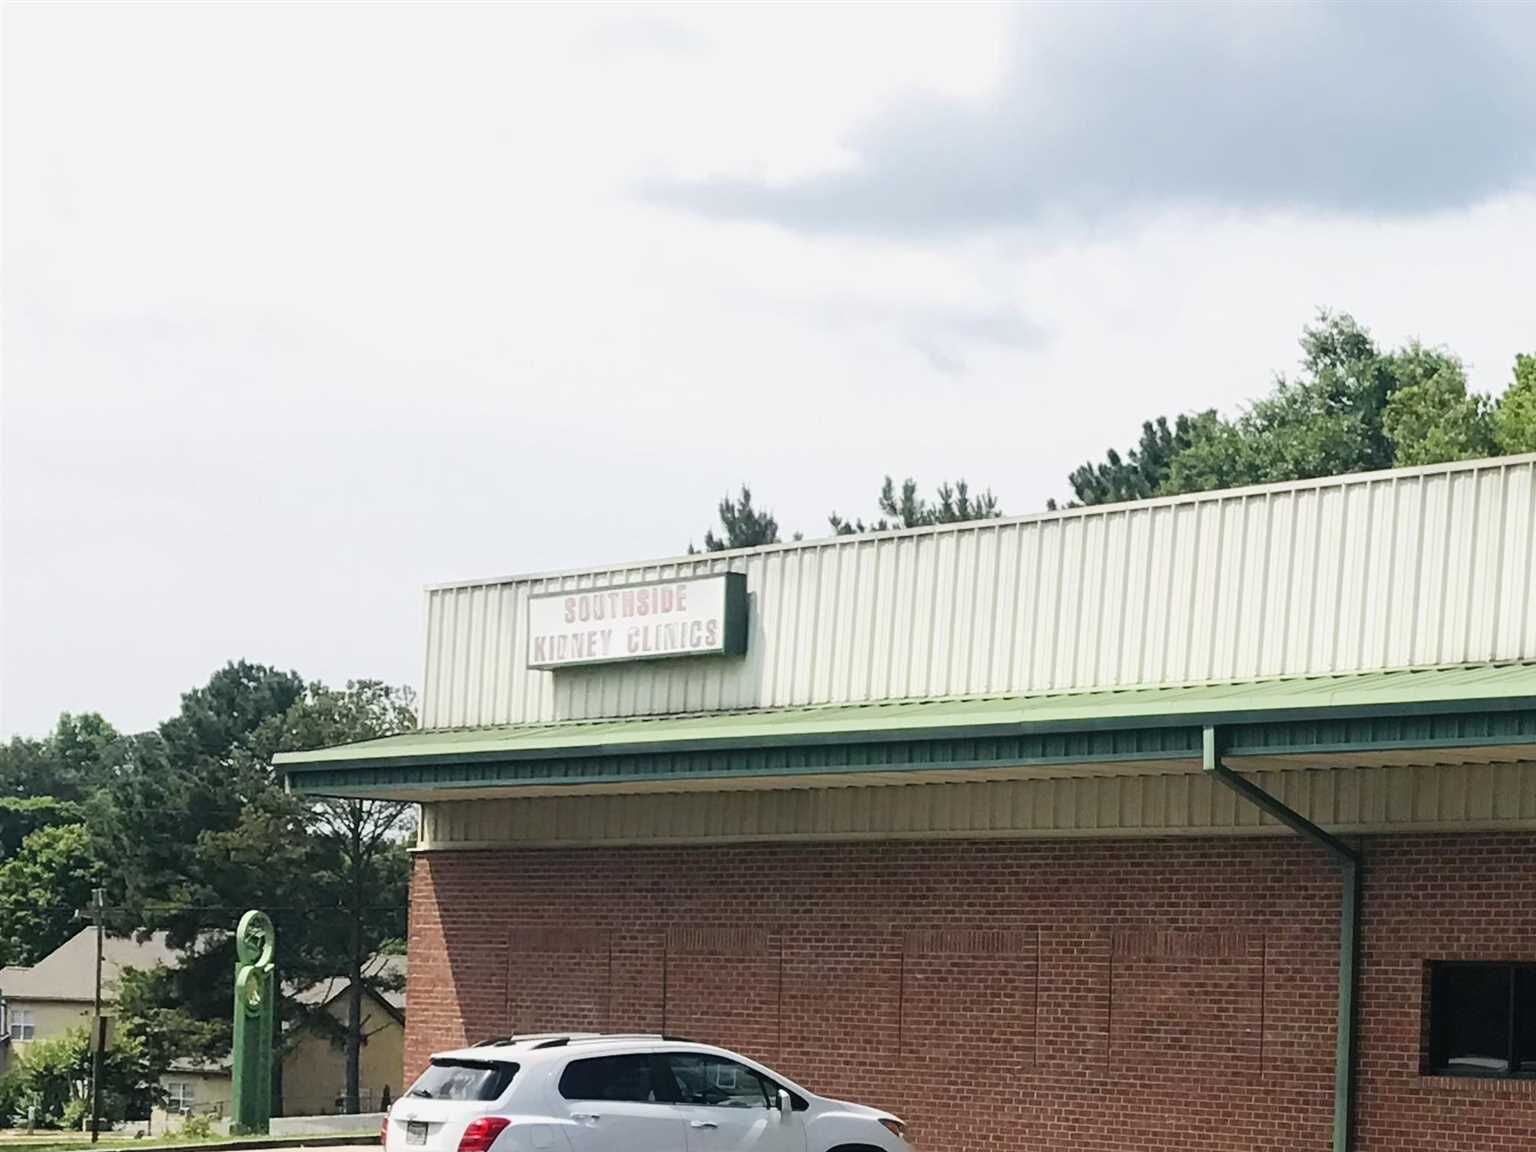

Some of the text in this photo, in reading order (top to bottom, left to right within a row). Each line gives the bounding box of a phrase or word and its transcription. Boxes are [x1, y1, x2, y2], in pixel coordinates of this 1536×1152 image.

[564, 584, 688, 624] SOUTHSIDE
[533, 618, 718, 663] KIDNEY CLINICS
